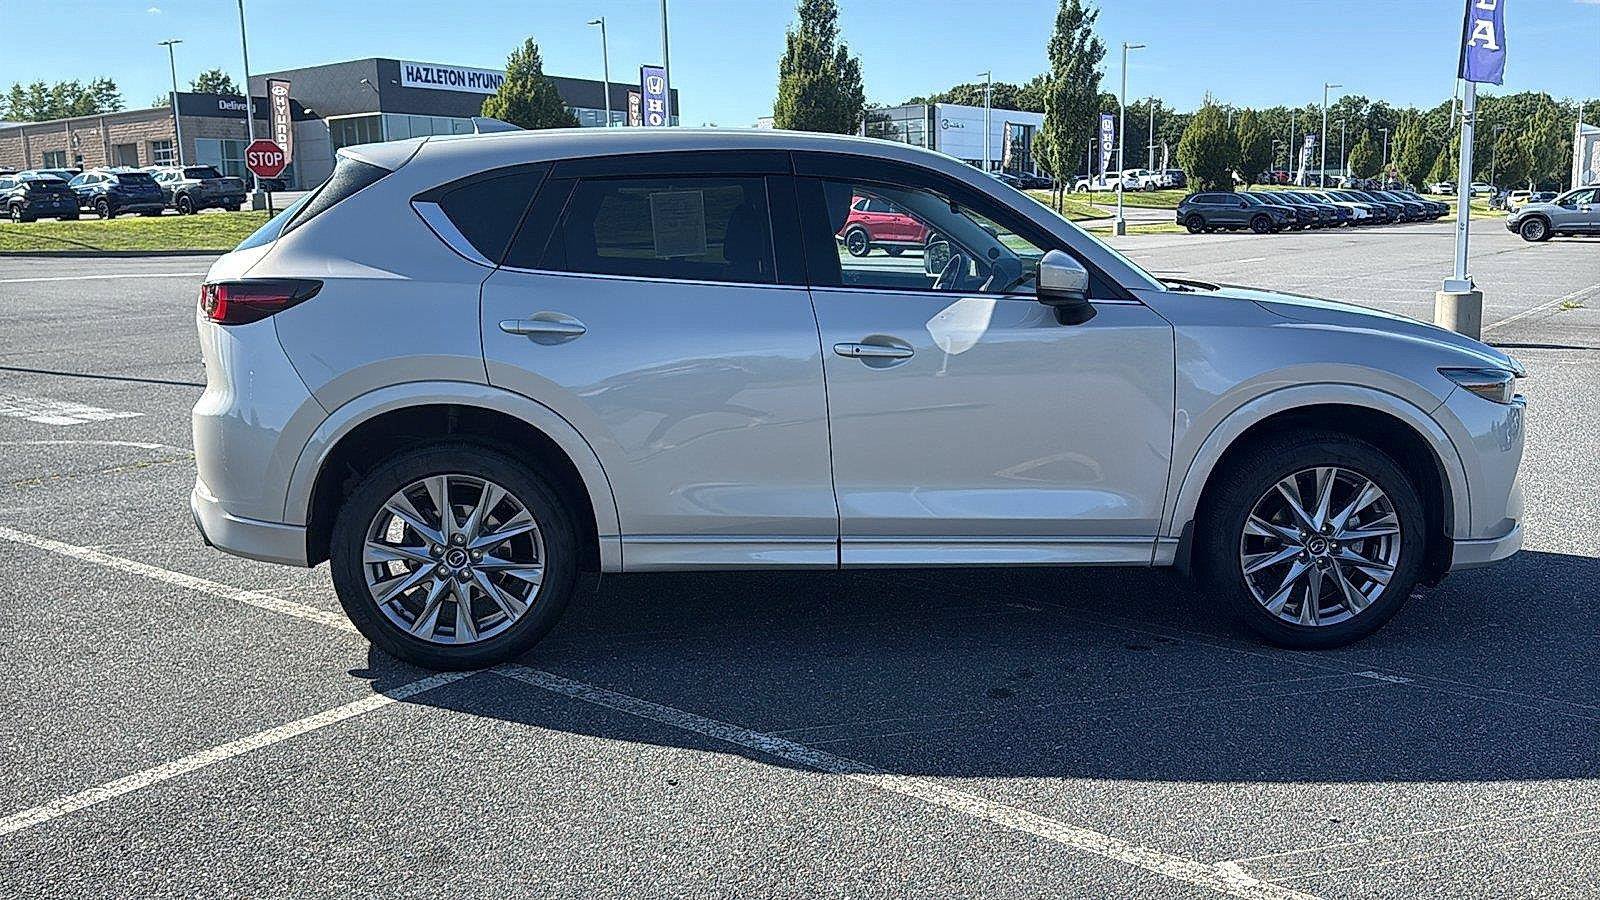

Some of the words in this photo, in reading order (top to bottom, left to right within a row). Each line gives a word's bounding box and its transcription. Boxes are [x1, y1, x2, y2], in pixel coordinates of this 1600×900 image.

[405, 65, 466, 87] HAZLETON
[218, 100, 256, 114] Delivey
[248, 151, 283, 167] STOP
